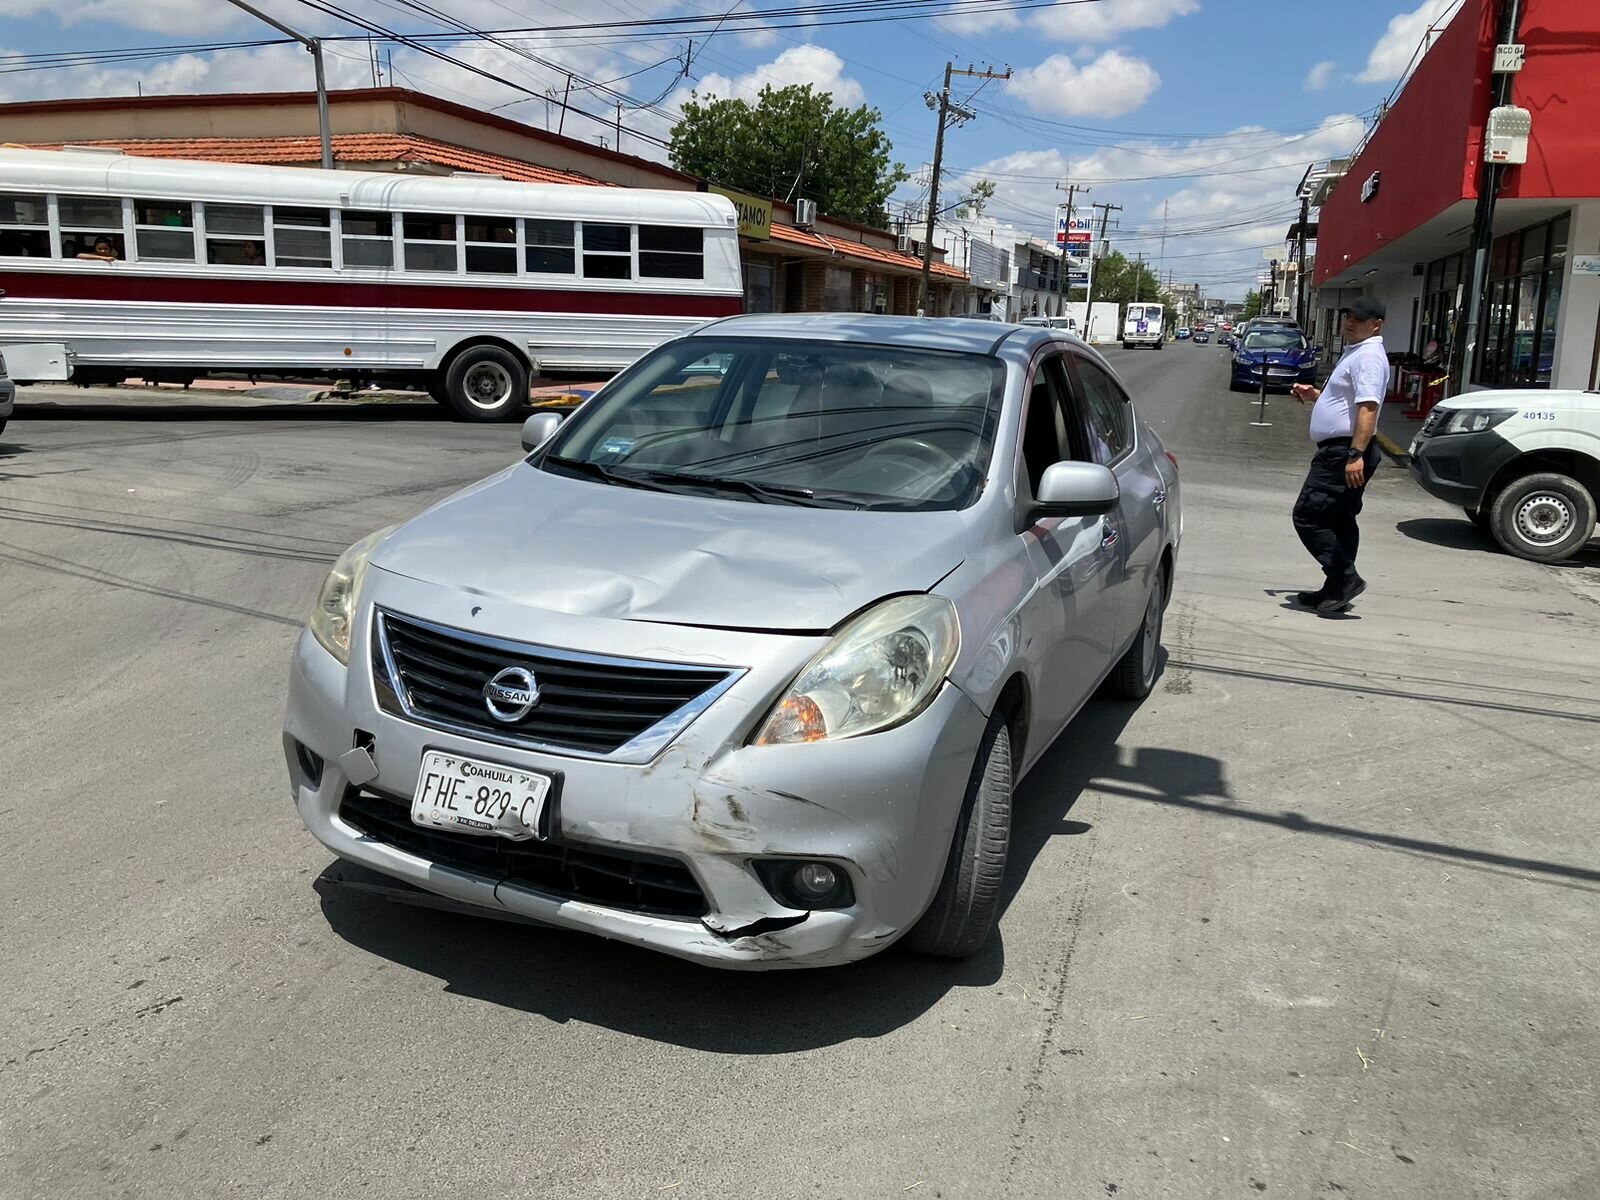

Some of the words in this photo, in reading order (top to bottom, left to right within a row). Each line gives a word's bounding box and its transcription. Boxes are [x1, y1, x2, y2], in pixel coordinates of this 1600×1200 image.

[1060, 219, 1090, 229] Mobil
[1523, 412, 1556, 420] 40135
[484, 685, 531, 702] NISSAN
[460, 762, 513, 784] COAHUILA
[421, 773, 535, 827] FHE-829-C
